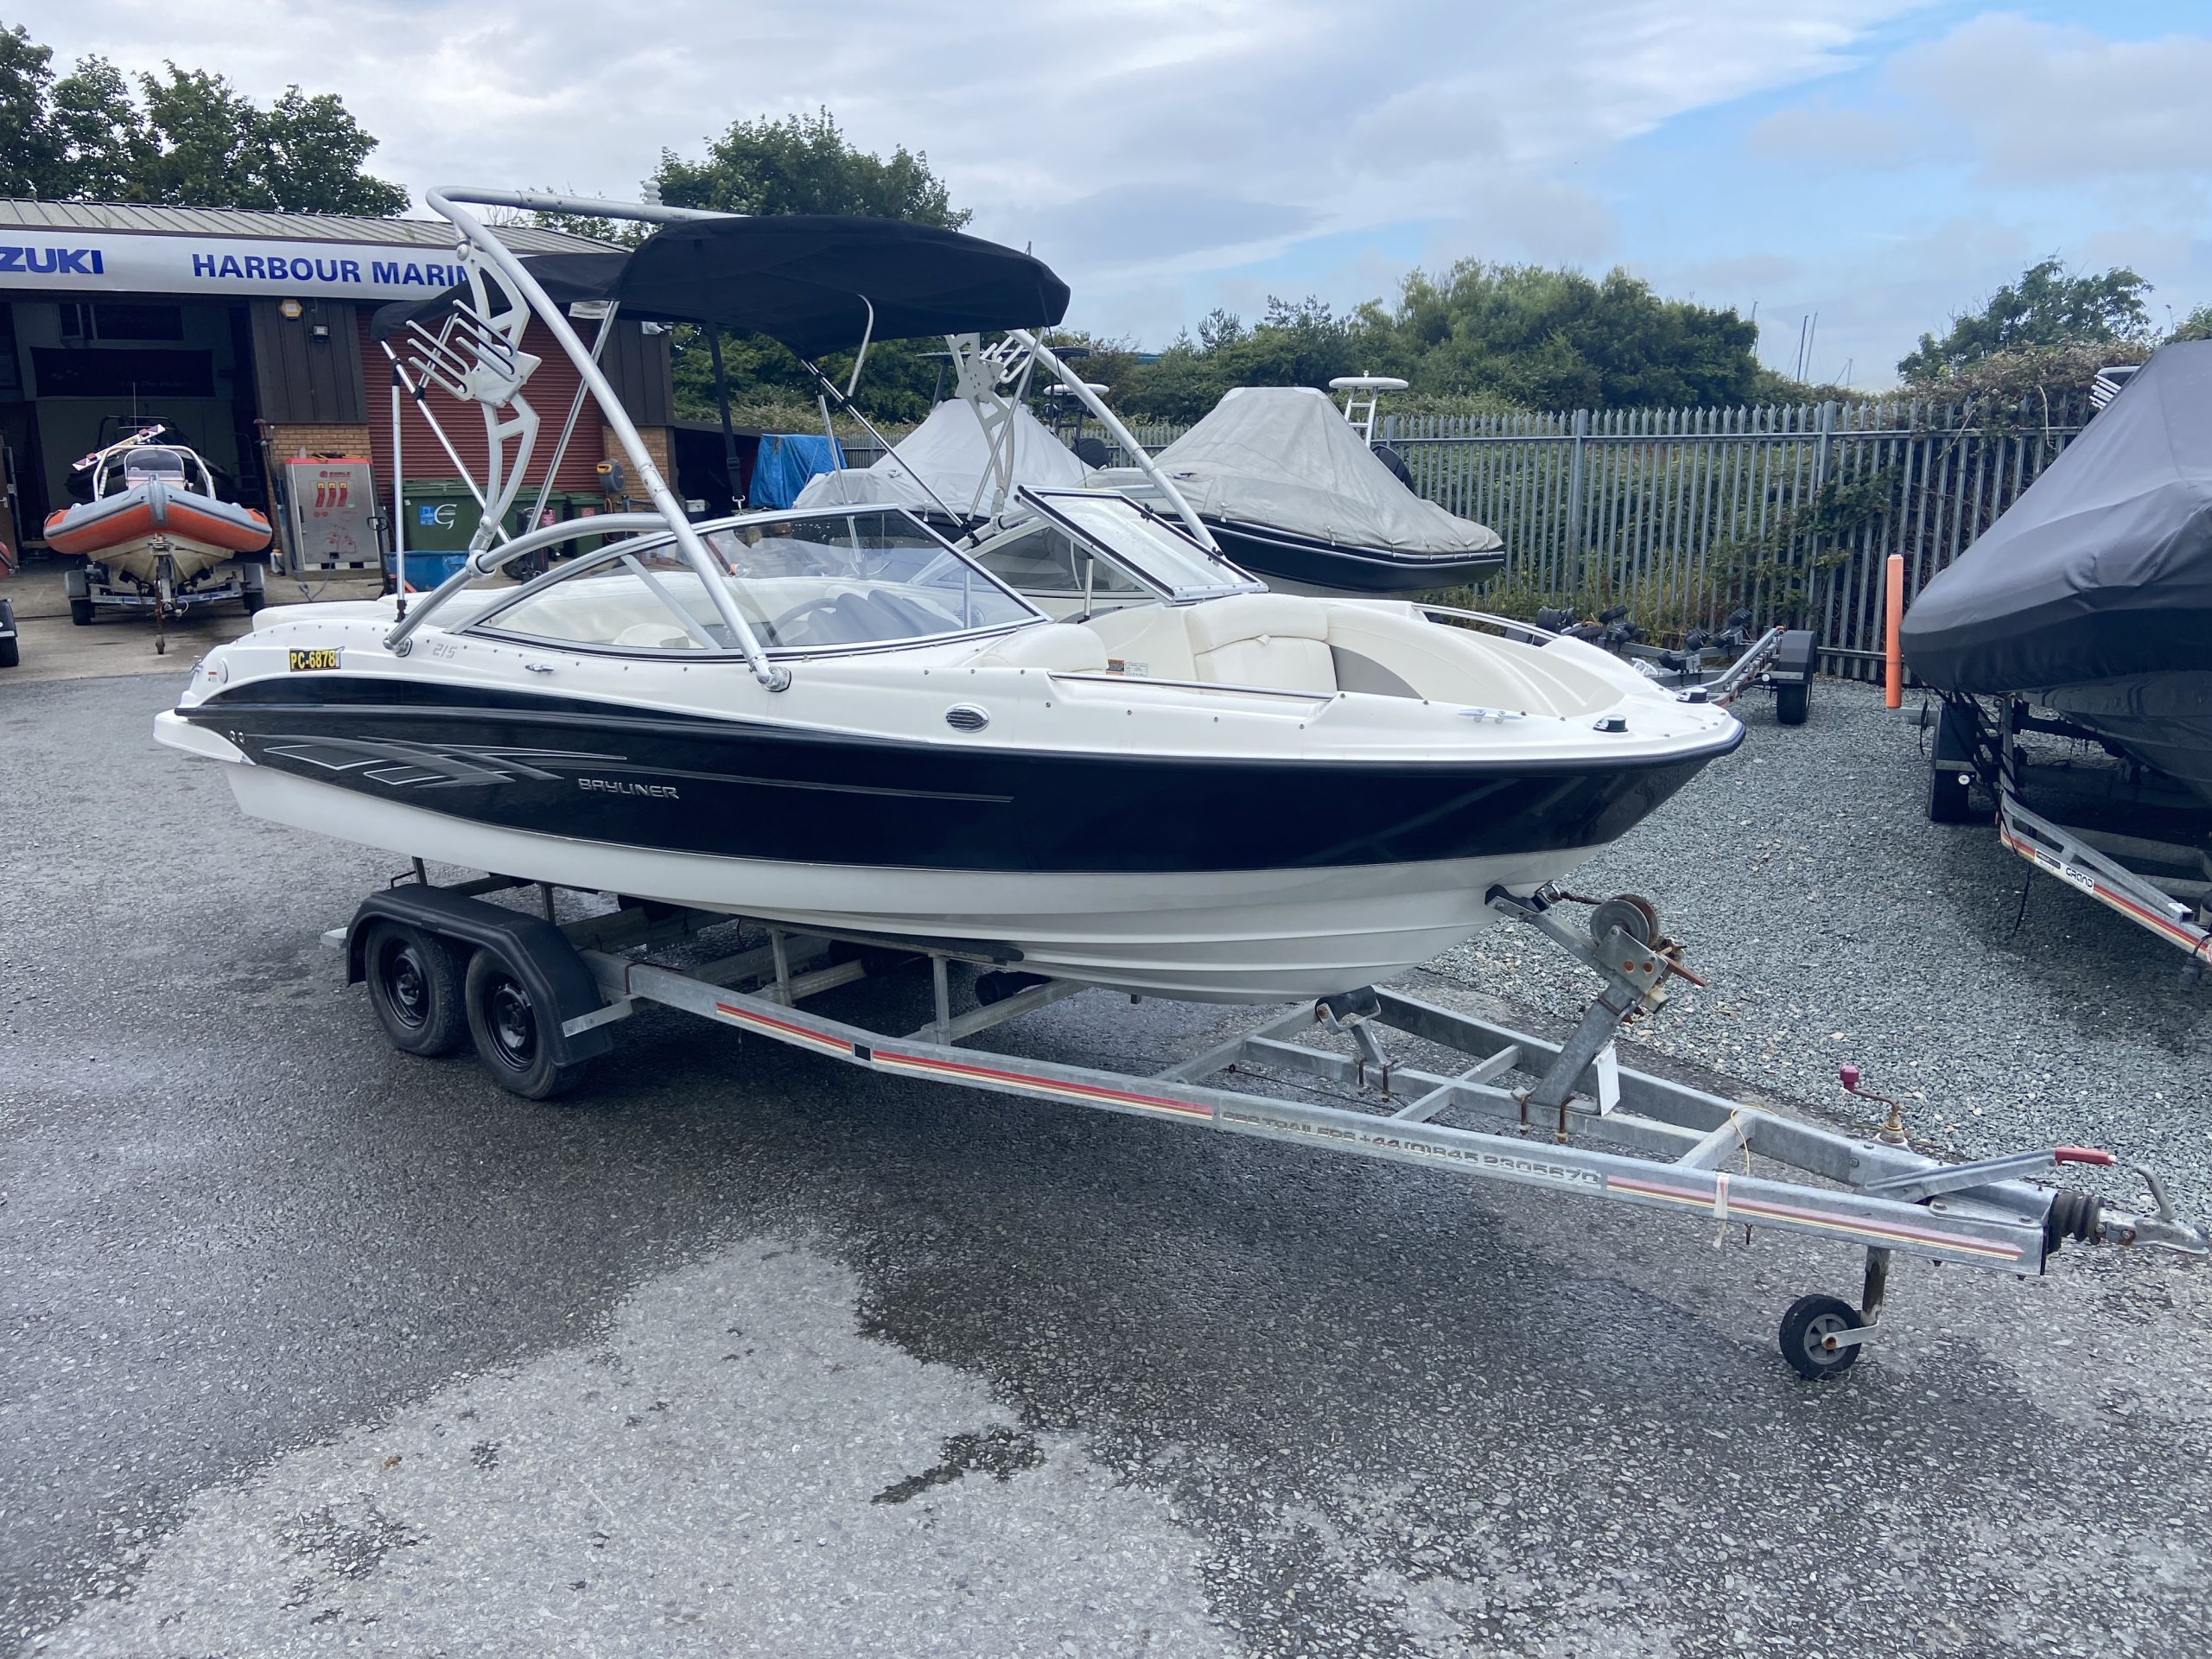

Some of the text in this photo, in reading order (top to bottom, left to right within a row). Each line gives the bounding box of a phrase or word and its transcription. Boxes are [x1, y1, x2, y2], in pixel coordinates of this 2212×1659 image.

[192, 253, 361, 284] HARBOUR
[289, 650, 335, 670] PC-6878
[432, 643, 458, 659] 215
[578, 778, 680, 799] BAYLINER
[2065, 867, 2094, 887] GRAND
[1262, 1117, 1356, 1142] TRAILERS
